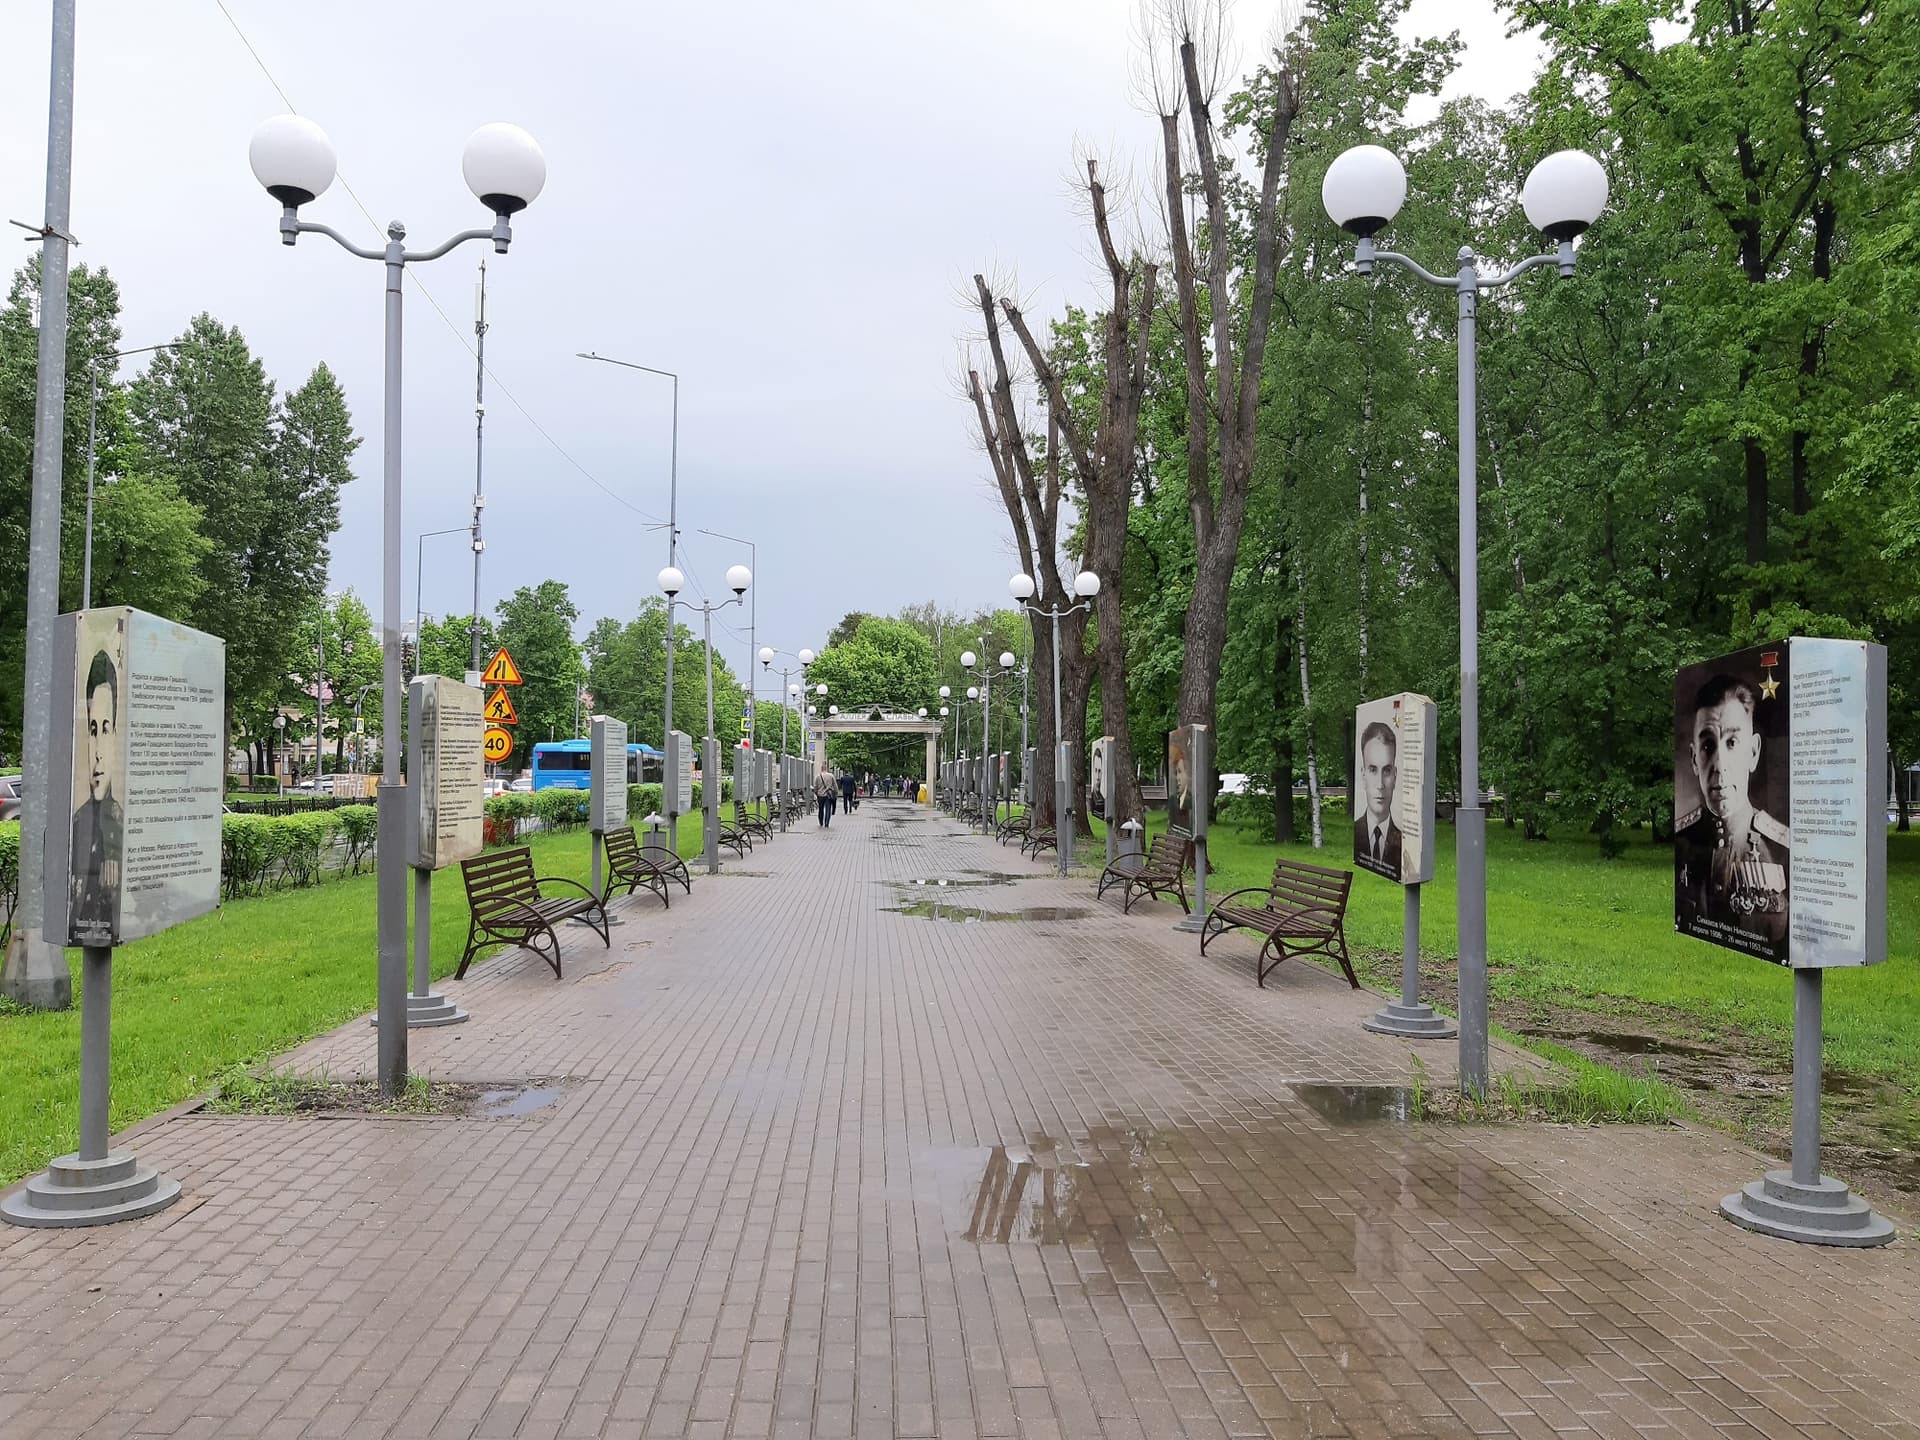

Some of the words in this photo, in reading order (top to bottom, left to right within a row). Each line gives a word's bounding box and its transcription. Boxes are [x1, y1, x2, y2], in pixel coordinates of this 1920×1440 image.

[485, 738, 505, 751] 40
[1696, 914, 1718, 928] Симаков
[1719, 921, 1732, 932] Иван
[1733, 926, 1768, 943] Николаевич
[1749, 941, 1762, 952] 1953
